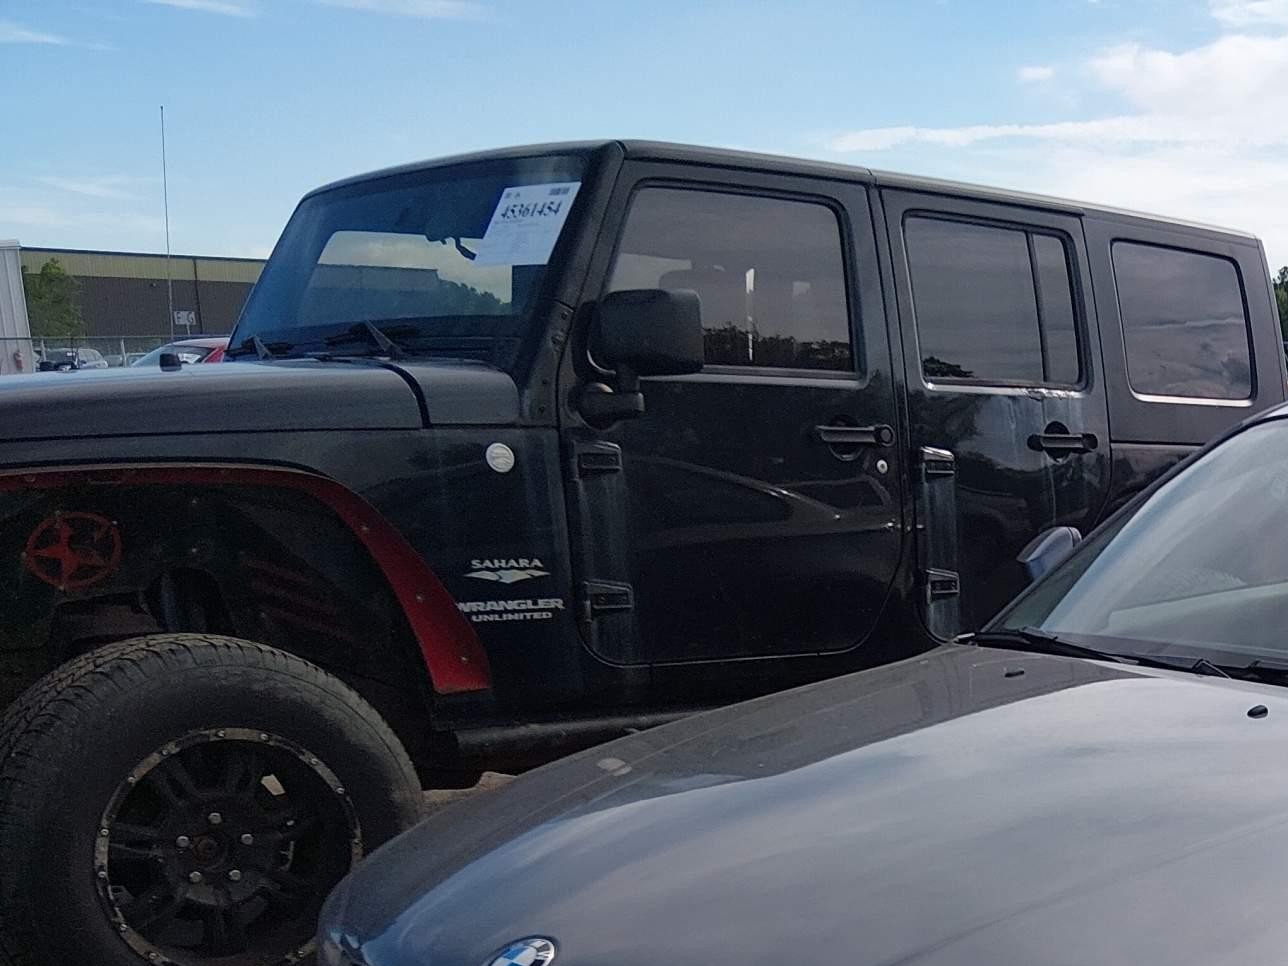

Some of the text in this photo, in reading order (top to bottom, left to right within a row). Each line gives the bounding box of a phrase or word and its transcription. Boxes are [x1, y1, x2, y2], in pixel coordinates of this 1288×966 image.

[501, 200, 563, 220] 45361454
[471, 558, 544, 569] SAHARA
[455, 598, 566, 613] WRANGLER
[471, 611, 553, 622] UNLIMITED
